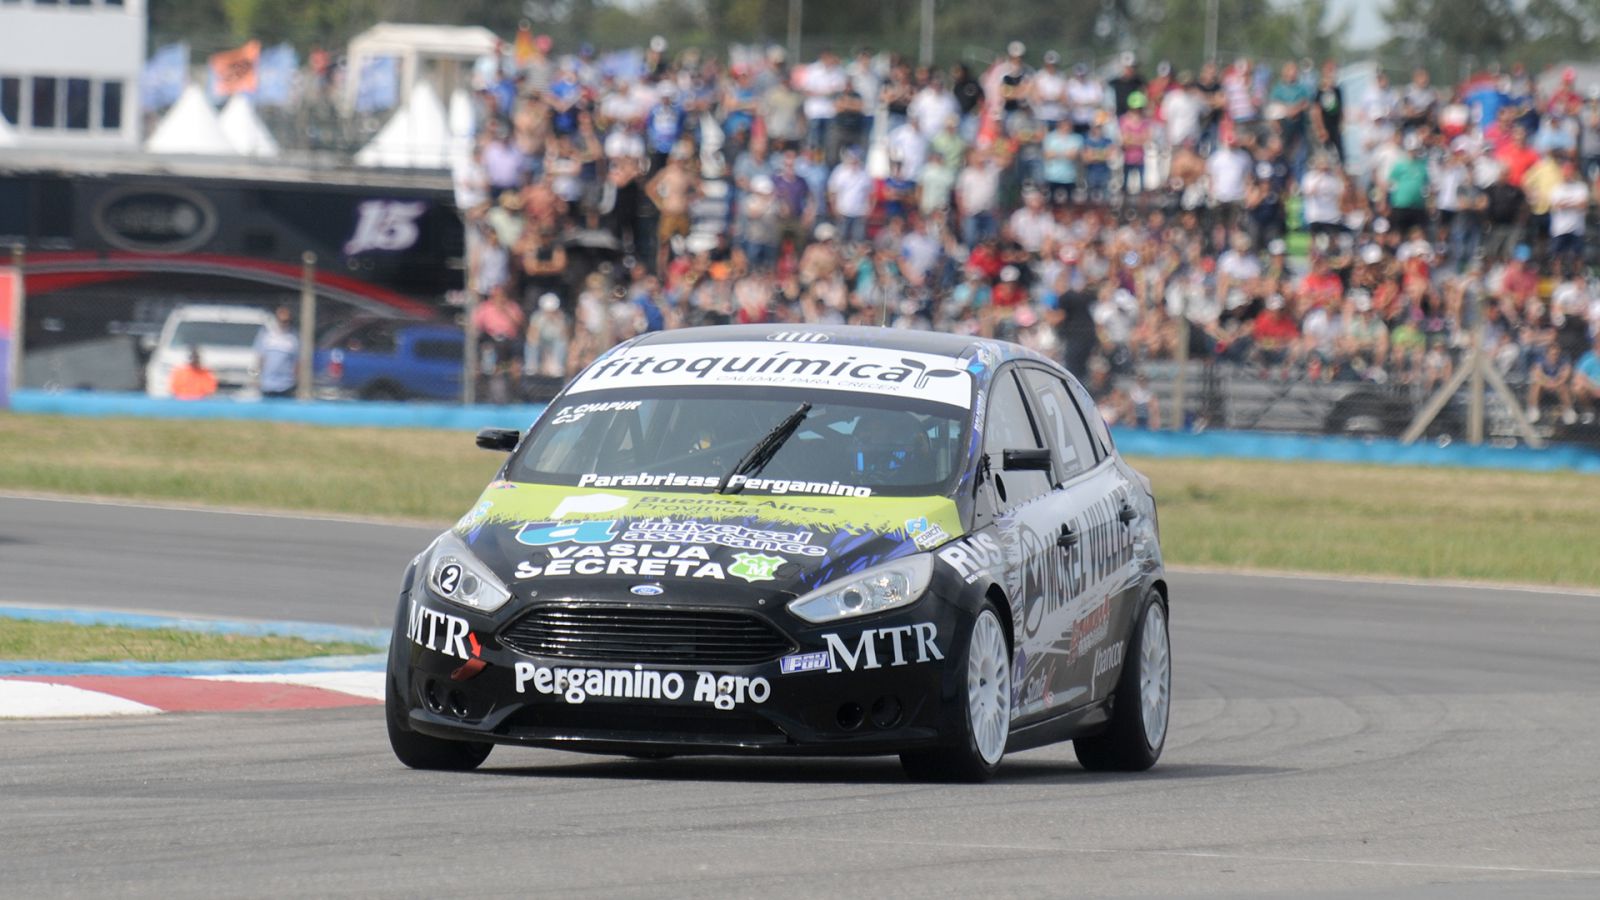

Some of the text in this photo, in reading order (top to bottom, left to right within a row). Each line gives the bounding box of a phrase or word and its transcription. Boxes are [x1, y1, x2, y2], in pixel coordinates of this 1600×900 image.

[343, 200, 426, 256] 15
[591, 351, 914, 383] fitoquímica
[1040, 392, 1077, 463] 2
[578, 472, 873, 498] Parabrisas Pergamino
[632, 502, 760, 515] Provincia
[639, 495, 836, 515] Buenos Aires
[621, 531, 829, 556] assistance
[629, 518, 813, 545] universal
[548, 543, 711, 561] VASIJA
[937, 532, 1002, 578] RUS
[441, 567, 459, 592] 2
[514, 558, 726, 580] SECRETA
[406, 599, 470, 660] MTR
[821, 622, 945, 674] MTR
[514, 661, 771, 711] Pergamino Agro
